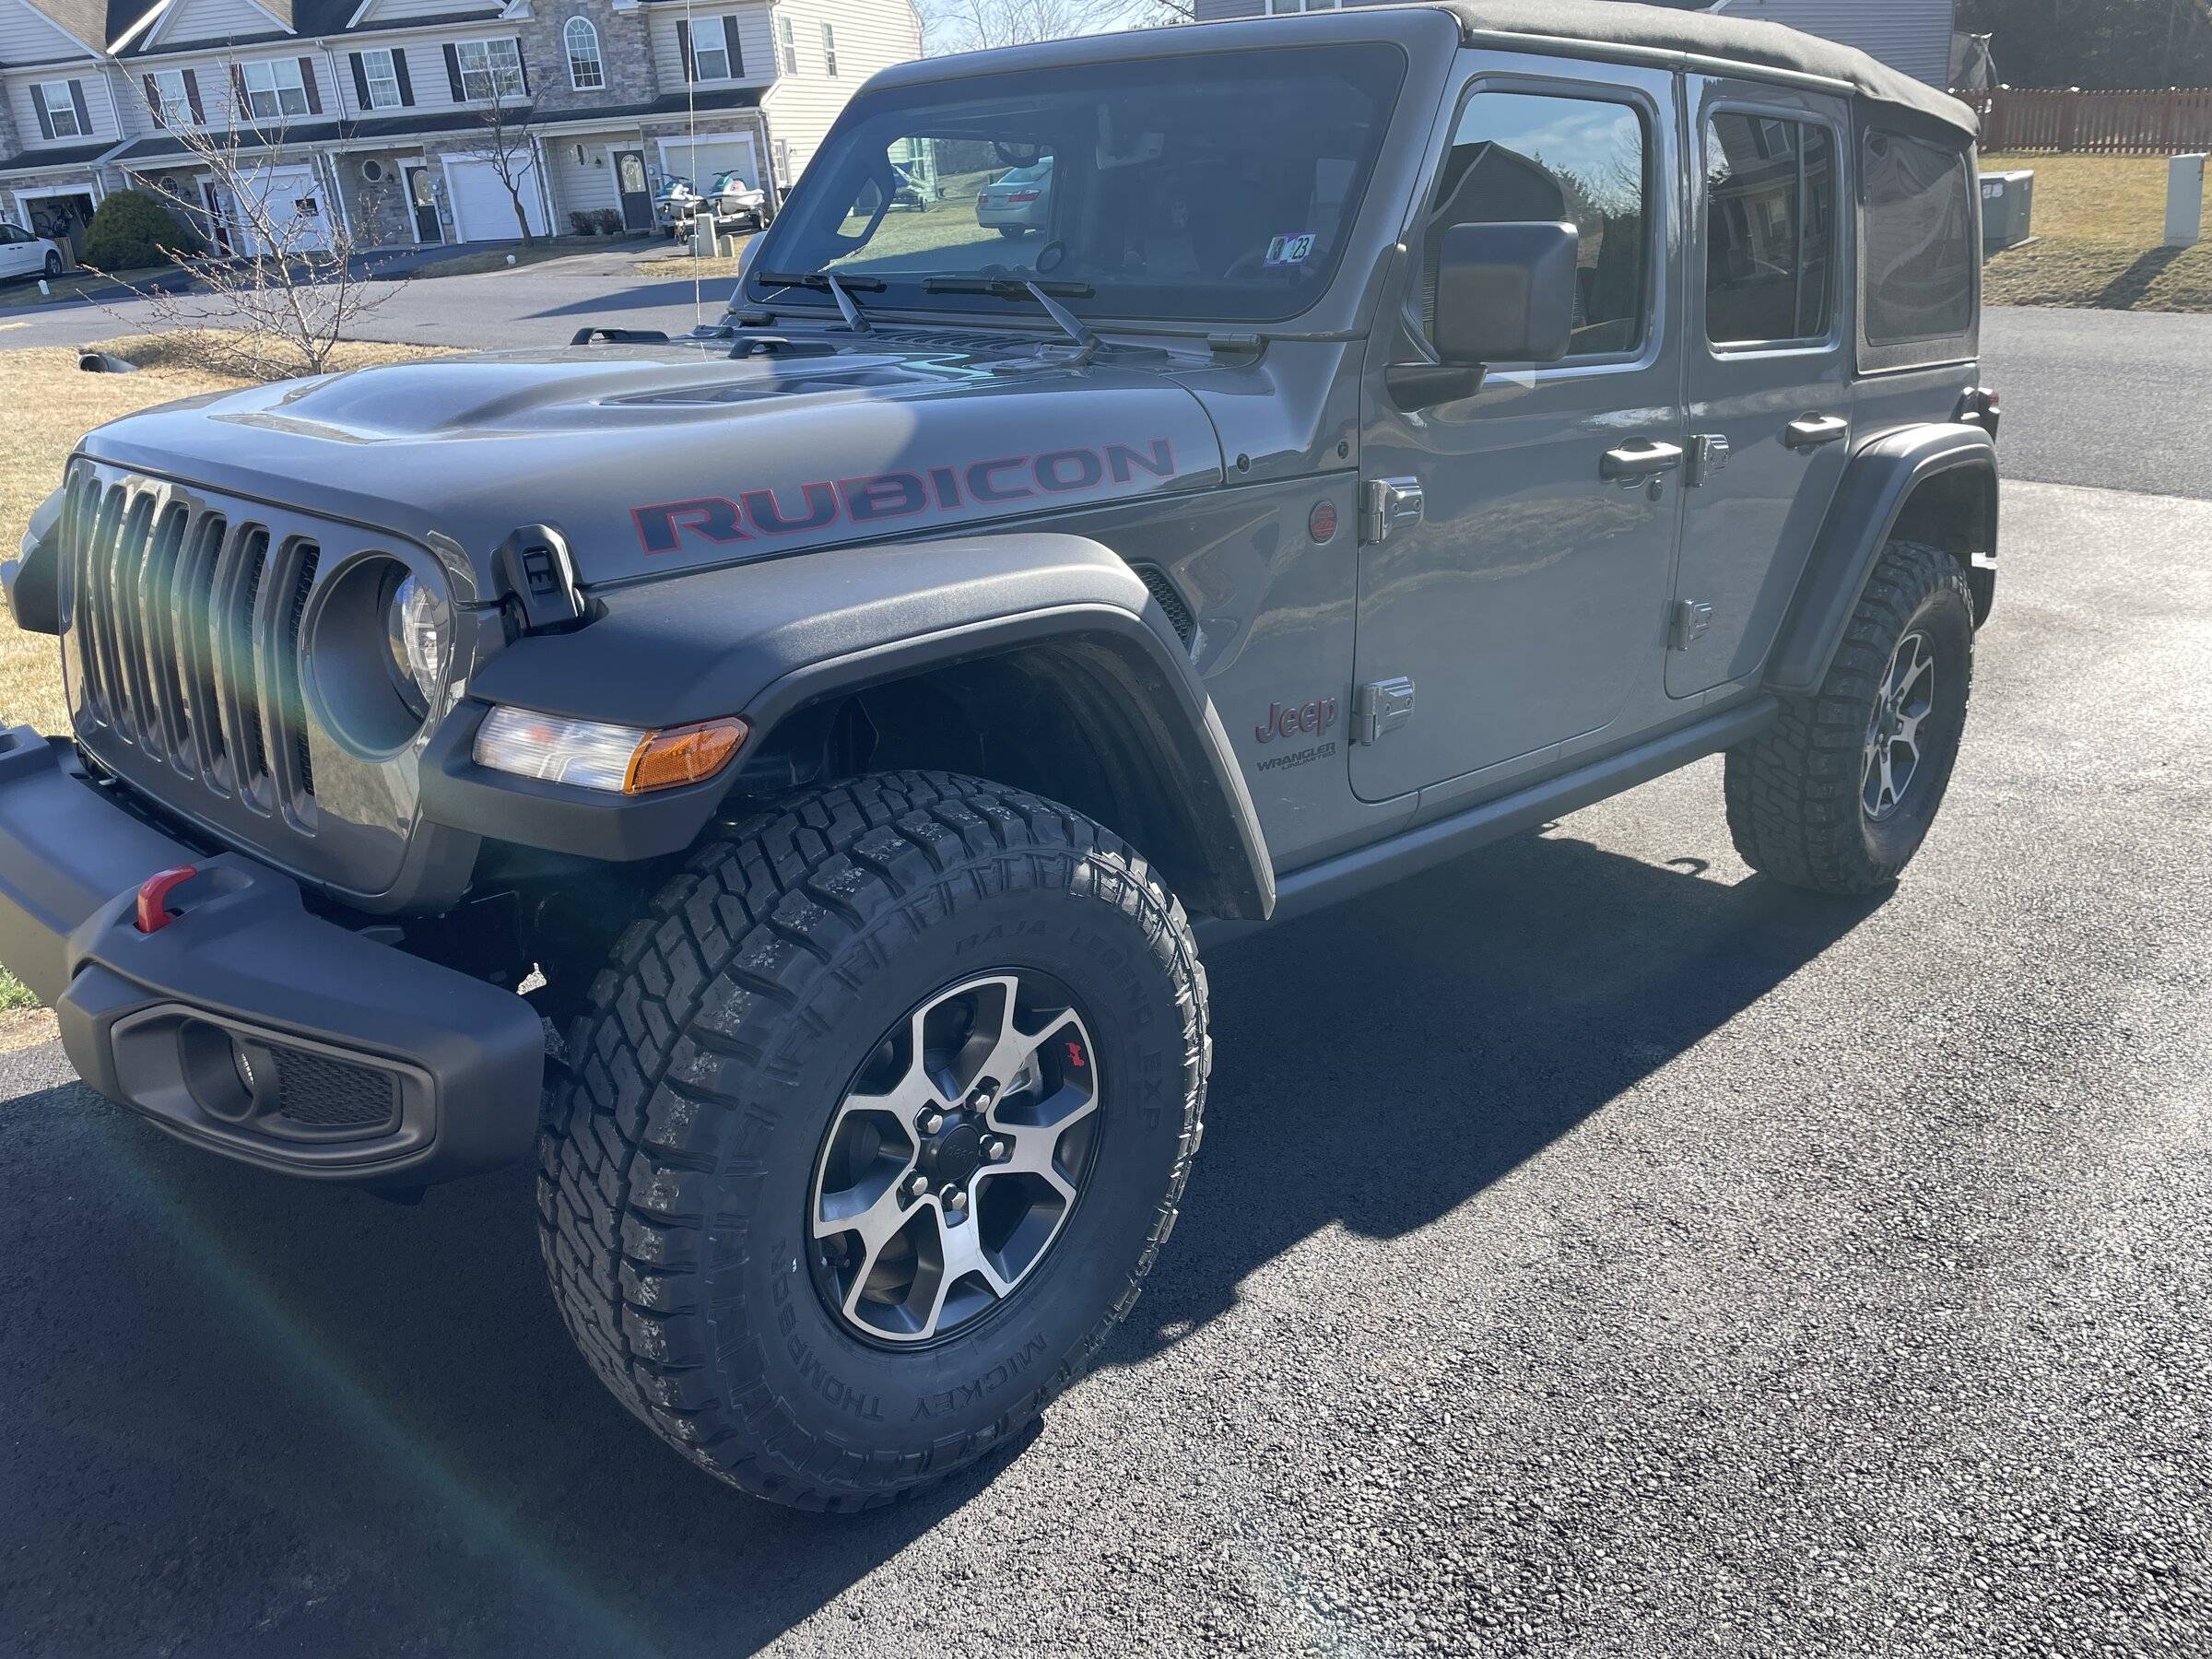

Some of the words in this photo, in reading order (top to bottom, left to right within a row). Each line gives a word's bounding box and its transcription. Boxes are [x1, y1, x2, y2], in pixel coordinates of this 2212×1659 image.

[1291, 237, 1310, 260] 23
[629, 438, 1177, 556] RUBICON
[1255, 698, 1335, 744] Jeep
[1256, 742, 1335, 772] WRANGLER
[770, 1237, 885, 1422] THOMPSON
[910, 1331, 1049, 1422] MICKEY
